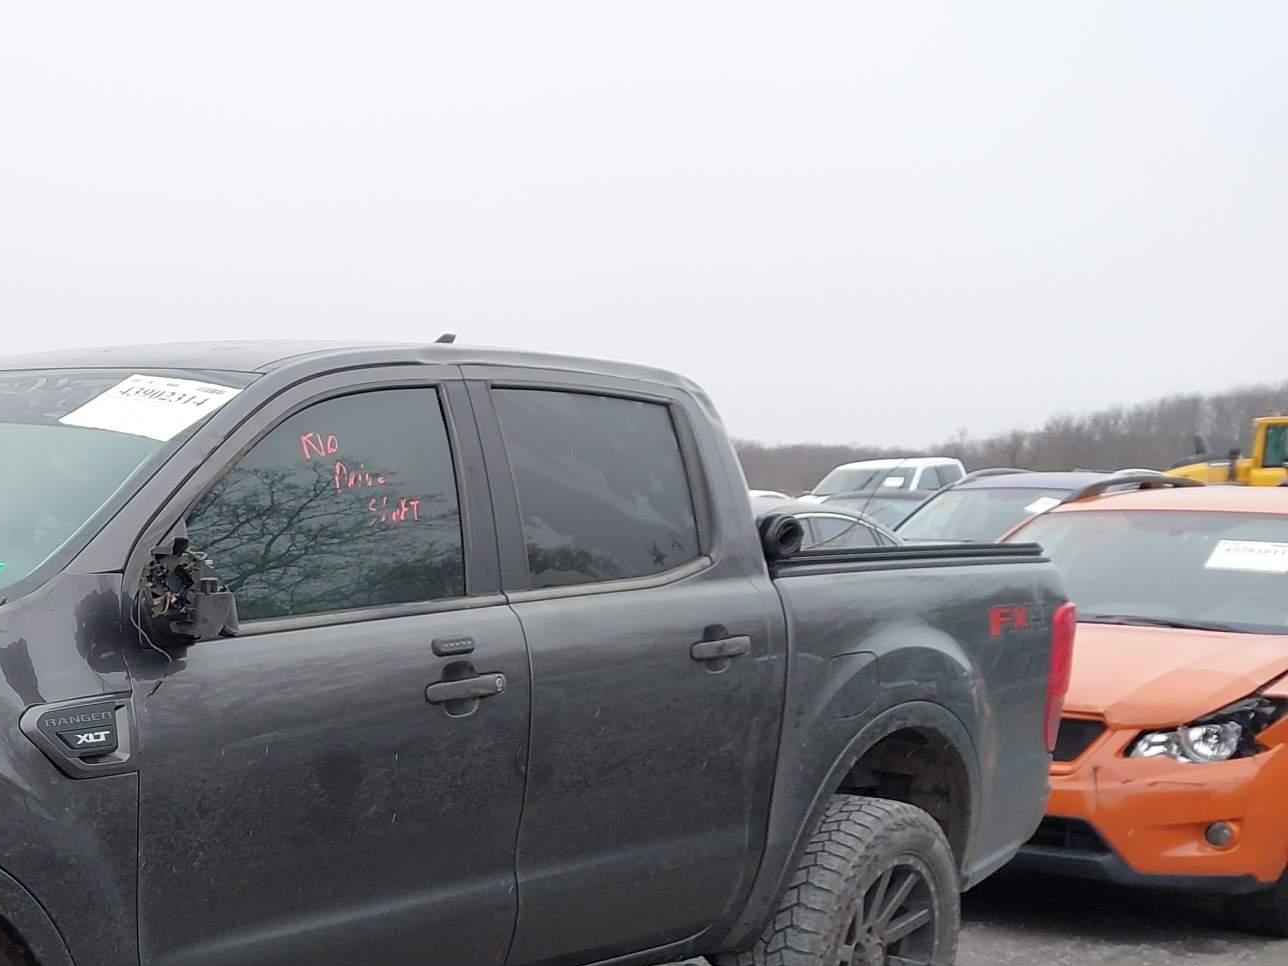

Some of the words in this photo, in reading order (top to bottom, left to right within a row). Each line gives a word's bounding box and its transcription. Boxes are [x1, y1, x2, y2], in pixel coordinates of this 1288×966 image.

[989, 602, 1049, 639] FX4
[44, 711, 112, 728] RANGER
[75, 730, 111, 745] XLT
